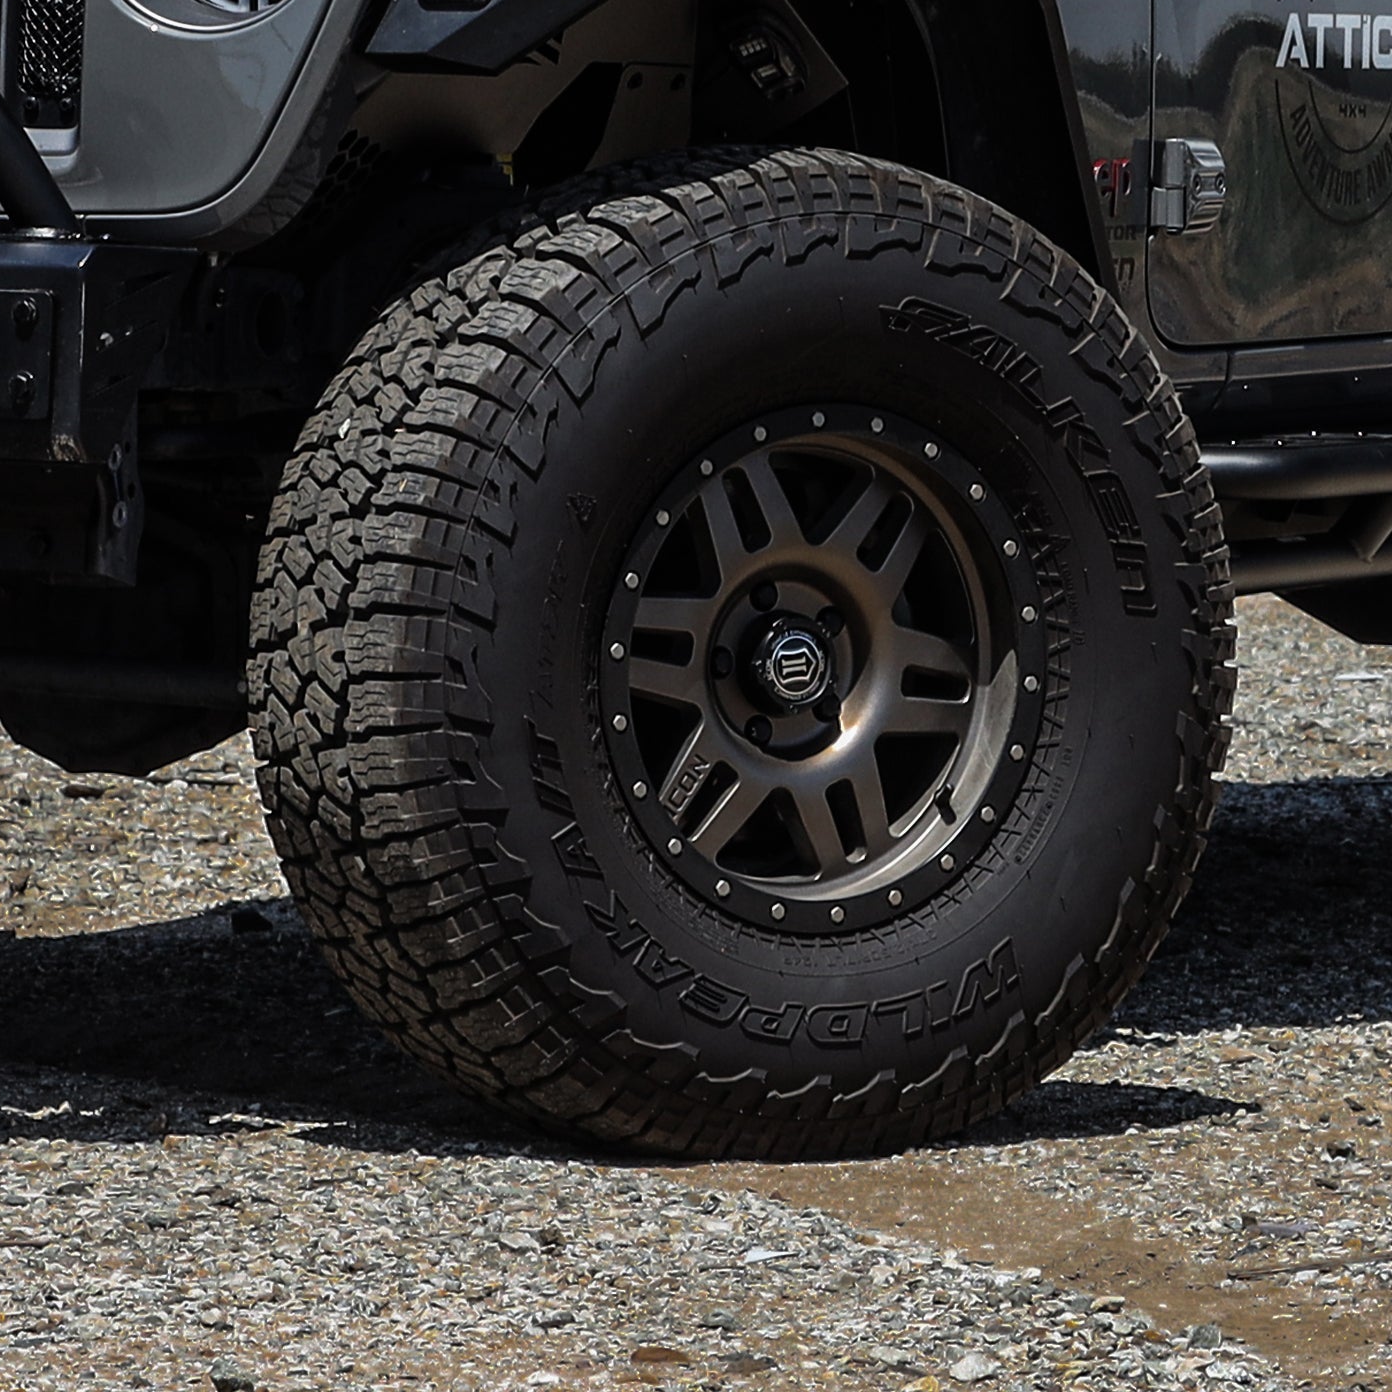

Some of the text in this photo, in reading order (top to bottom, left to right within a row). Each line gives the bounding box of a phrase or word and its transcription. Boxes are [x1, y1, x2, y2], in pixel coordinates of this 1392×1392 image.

[1290, 103, 1363, 207] ADVENTURE
[876, 295, 1158, 618] FALKEN
[581, 889, 1024, 1051] WILDPEAK
